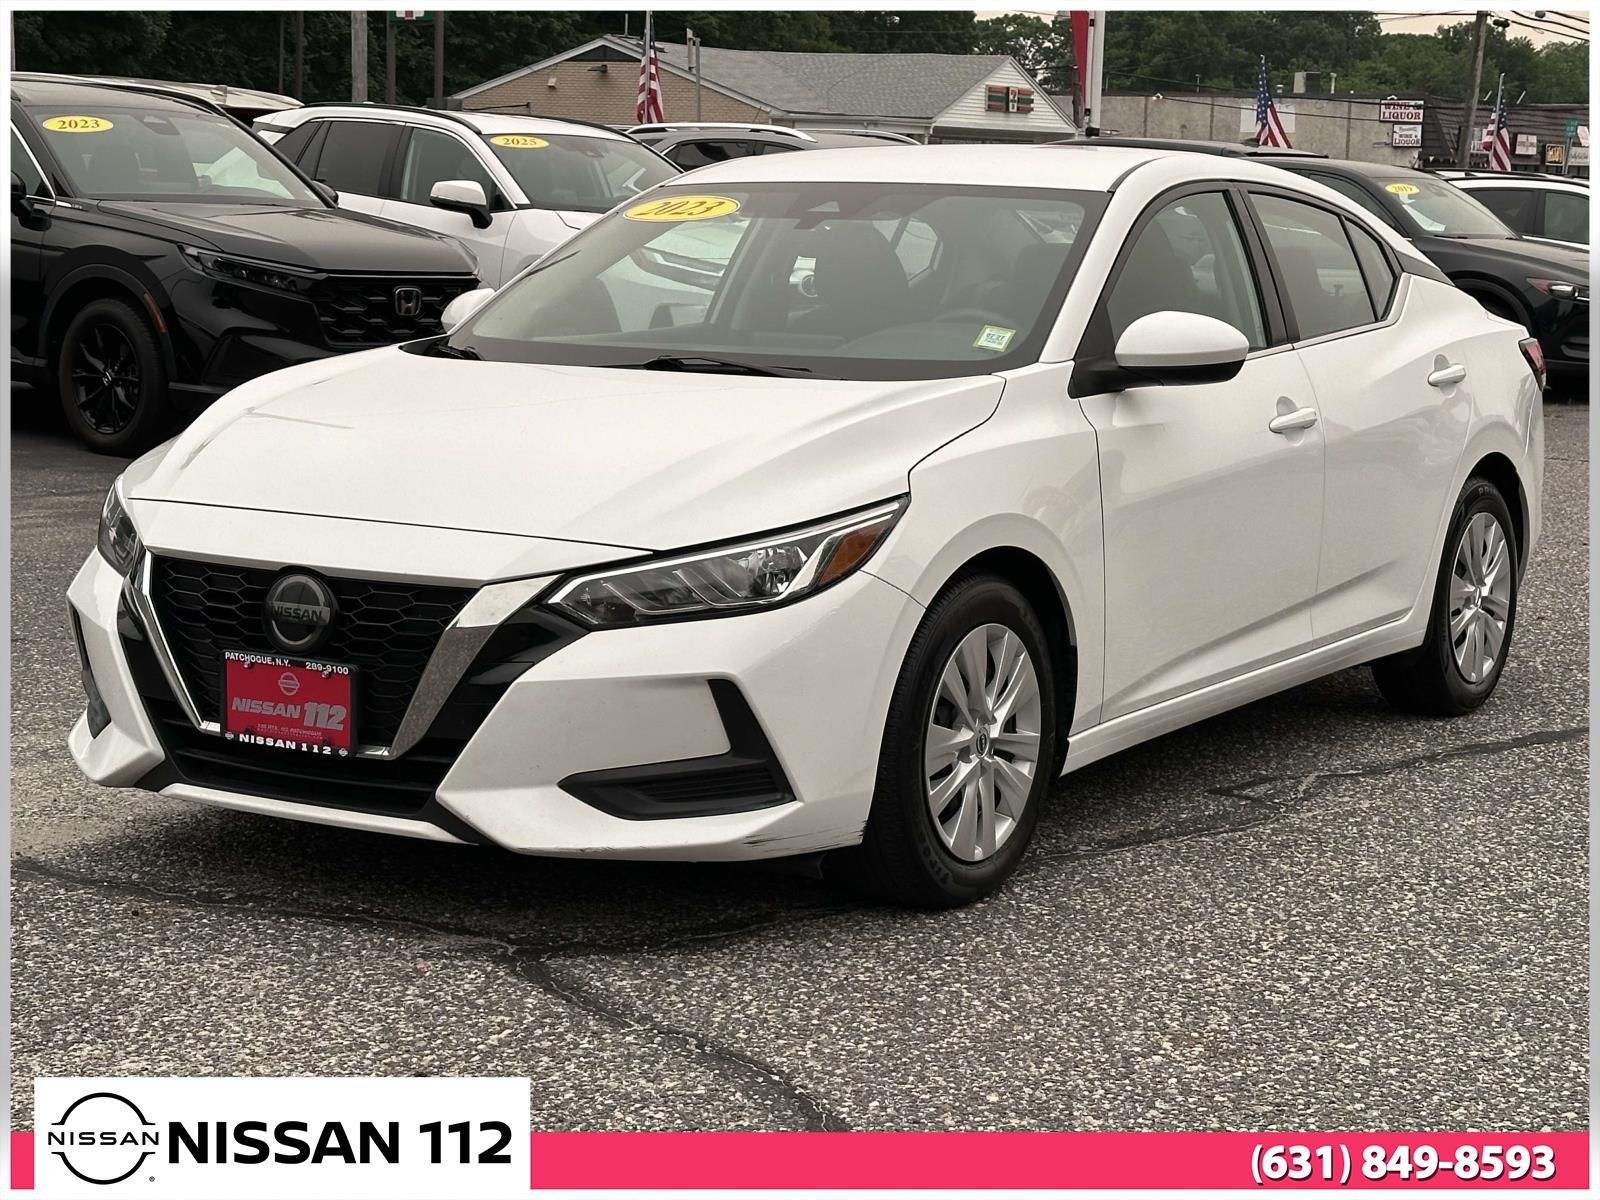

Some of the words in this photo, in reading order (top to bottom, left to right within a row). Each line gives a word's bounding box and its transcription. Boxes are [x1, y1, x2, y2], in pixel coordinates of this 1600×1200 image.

[1382, 111, 1421, 120] LIQUOR
[57, 119, 100, 130] 2023
[502, 137, 537, 146] 2025
[634, 201, 726, 216] 2023
[272, 605, 322, 622] NISSAN
[232, 697, 301, 719] NISSAN
[303, 701, 347, 731] 112
[239, 733, 297, 750] NISSAN
